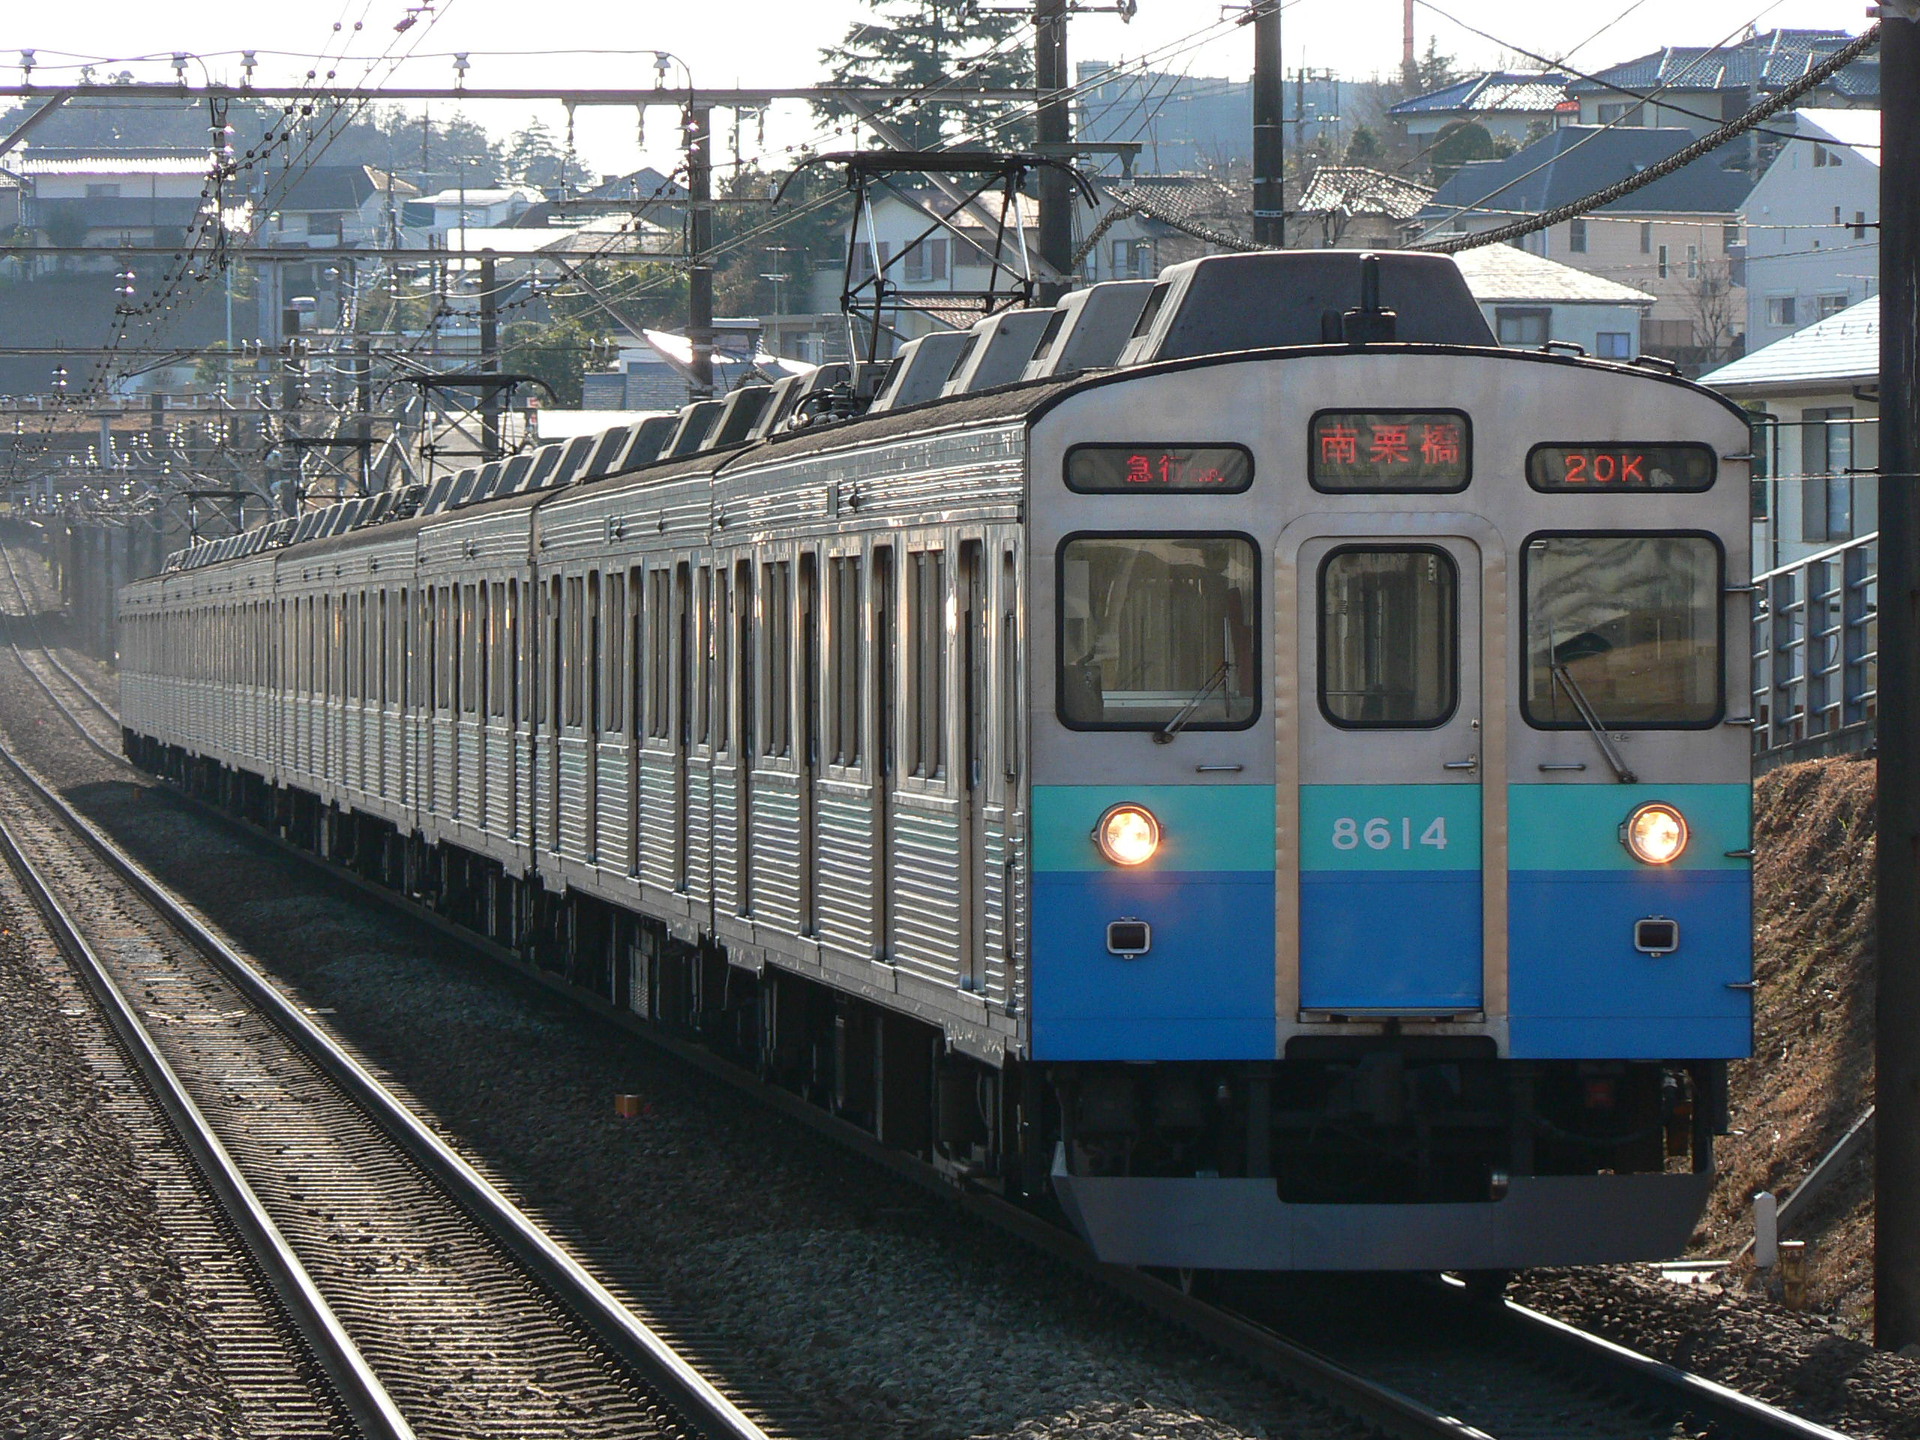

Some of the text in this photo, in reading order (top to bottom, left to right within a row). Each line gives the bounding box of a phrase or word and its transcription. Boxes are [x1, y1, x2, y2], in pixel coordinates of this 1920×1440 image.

[1319, 424, 1459, 464] 南栗橋
[1565, 454, 1644, 482] 20K
[1332, 817, 1447, 850] 8614
